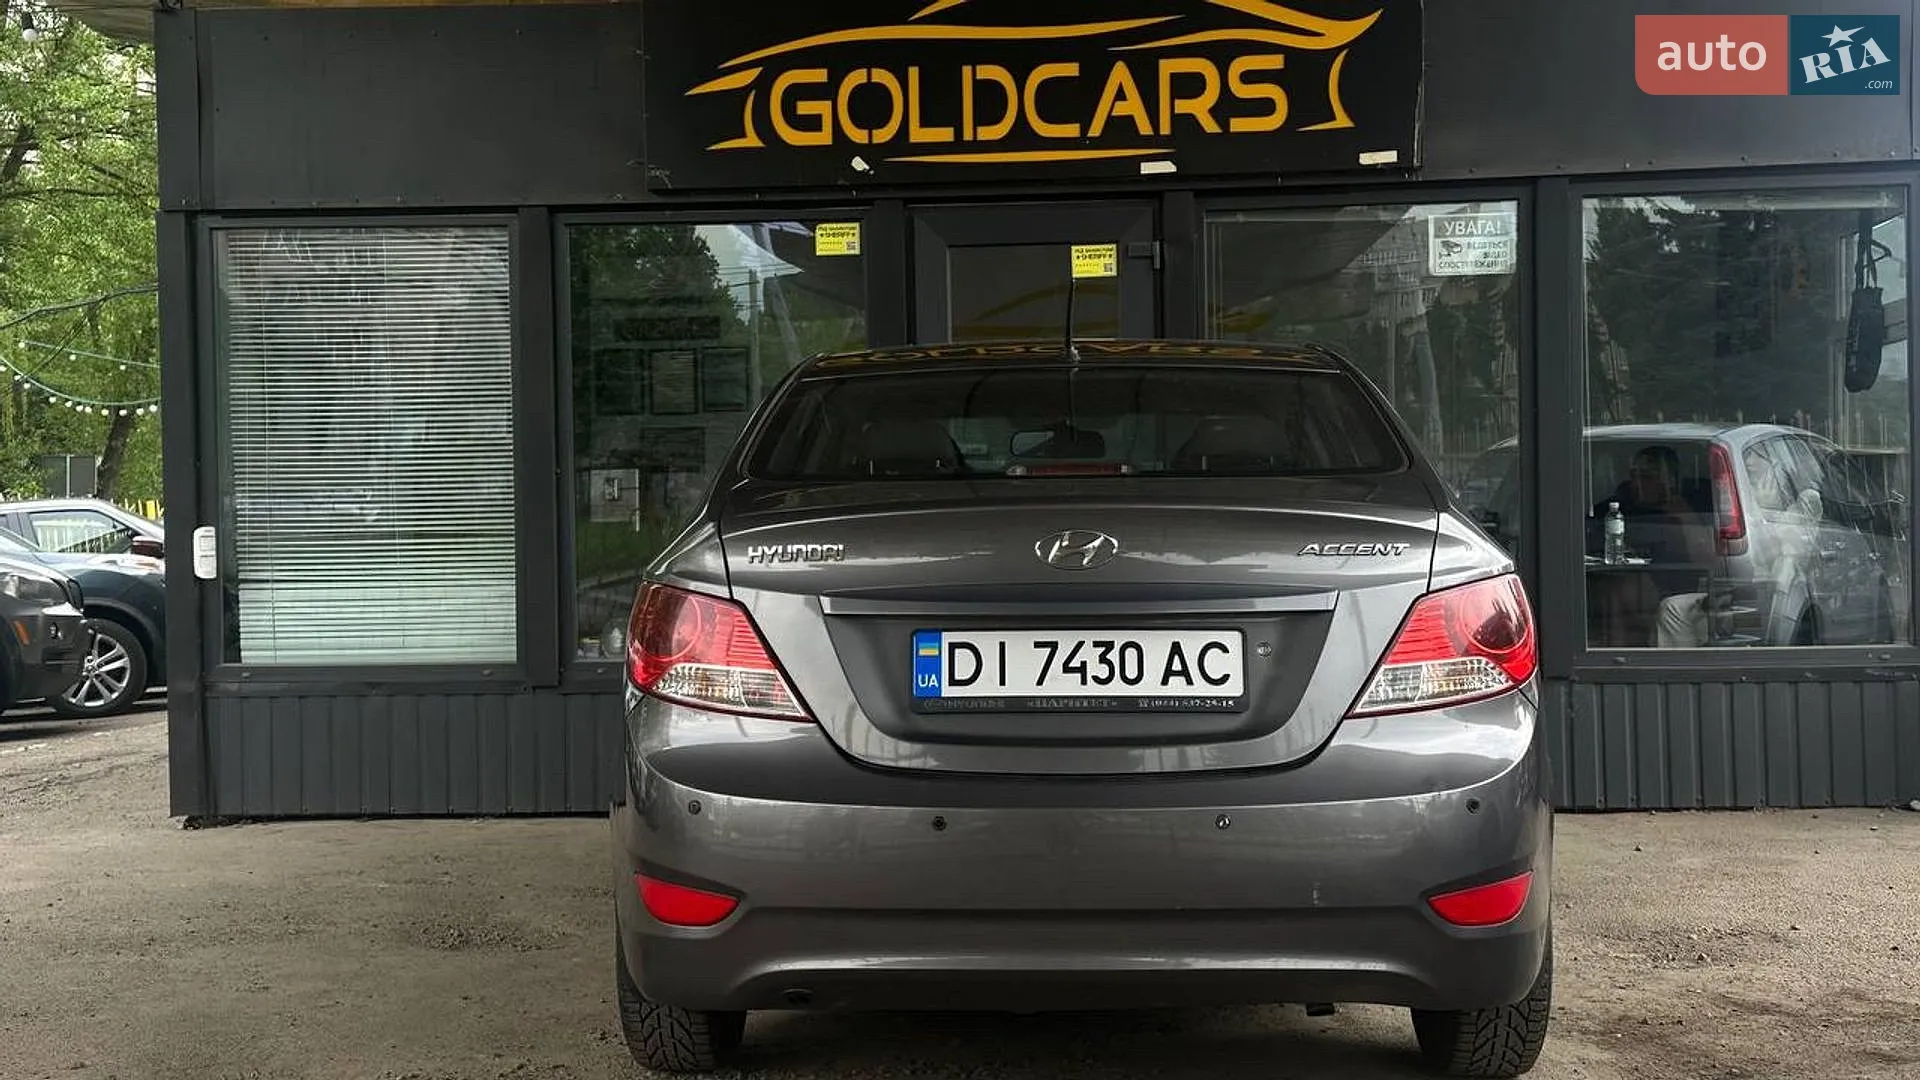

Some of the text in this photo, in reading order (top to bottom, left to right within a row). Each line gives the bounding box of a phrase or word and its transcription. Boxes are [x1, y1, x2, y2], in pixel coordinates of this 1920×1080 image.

[769, 54, 1289, 147] GOLDCARS
[1443, 219, 1501, 236] УВАГА!
[748, 544, 845, 564] HYUNDAI
[1297, 542, 1411, 556] ACCENT
[947, 640, 1231, 687] DI 7430 AC
[918, 674, 939, 688] UA
